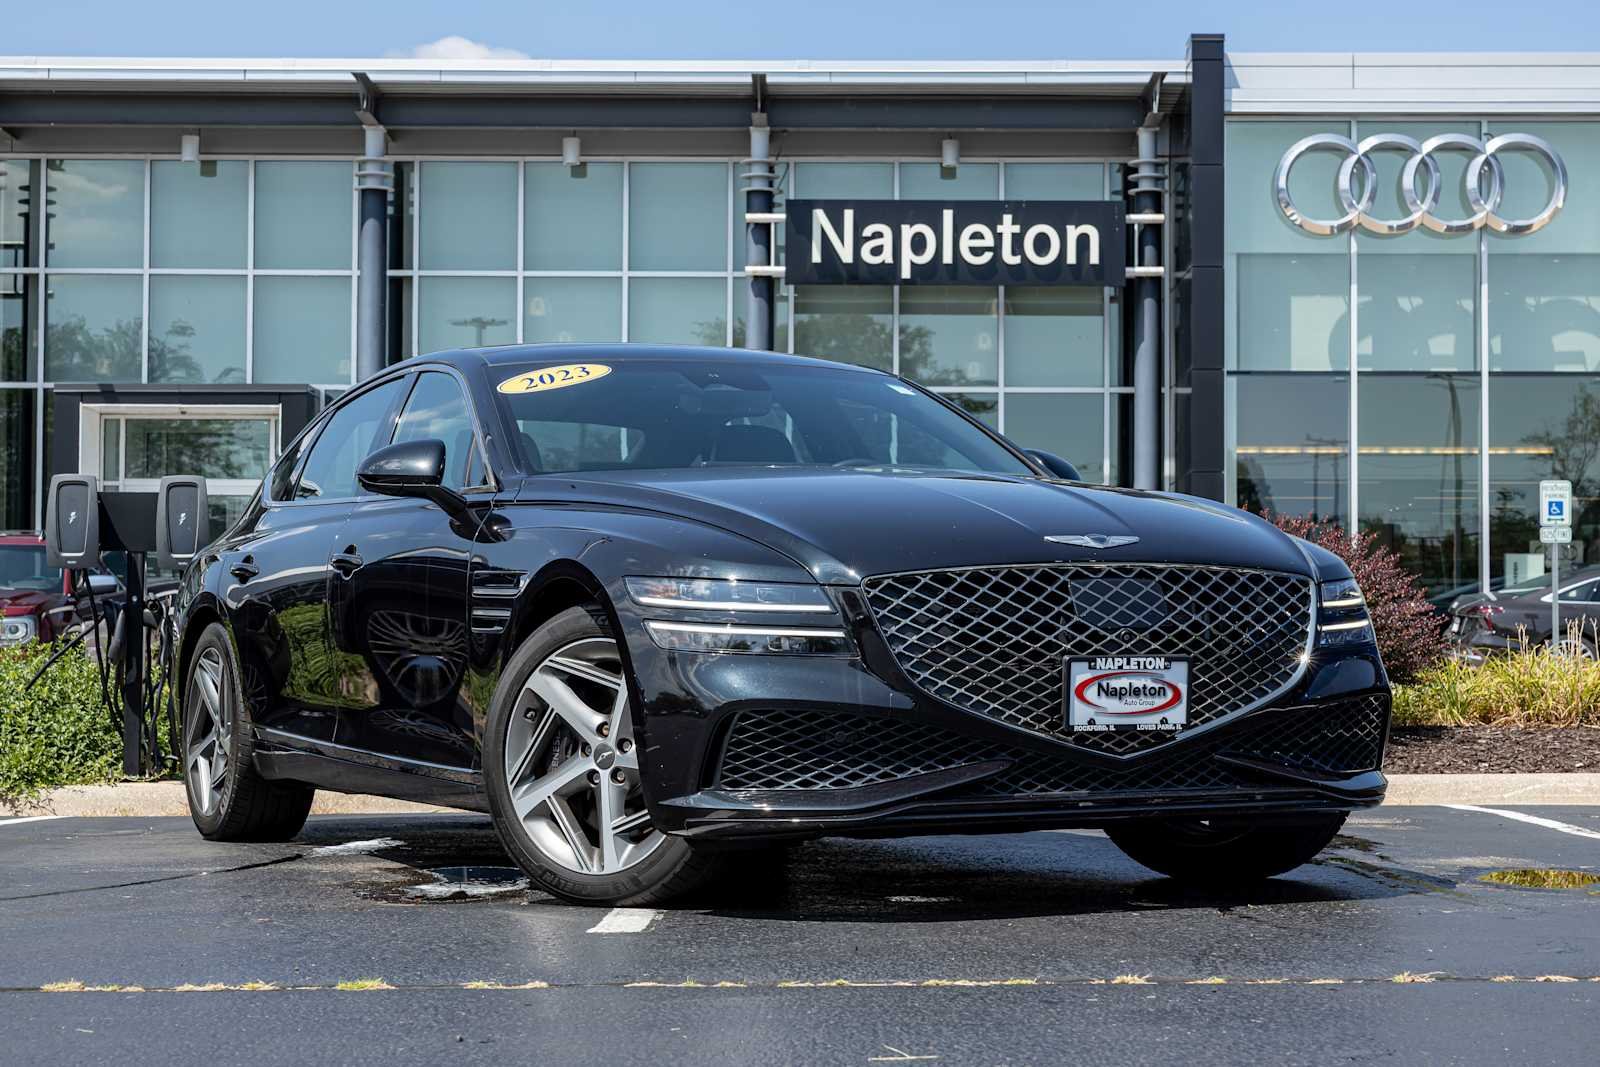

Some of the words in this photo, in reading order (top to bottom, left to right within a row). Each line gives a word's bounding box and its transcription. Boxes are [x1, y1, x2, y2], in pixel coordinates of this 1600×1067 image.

[811, 208, 1100, 279] Napleton
[520, 366, 590, 390] 2023
[1096, 657, 1165, 670] NAPLETON
[1097, 682, 1166, 701] Napleton
[1139, 699, 1156, 707] Group
